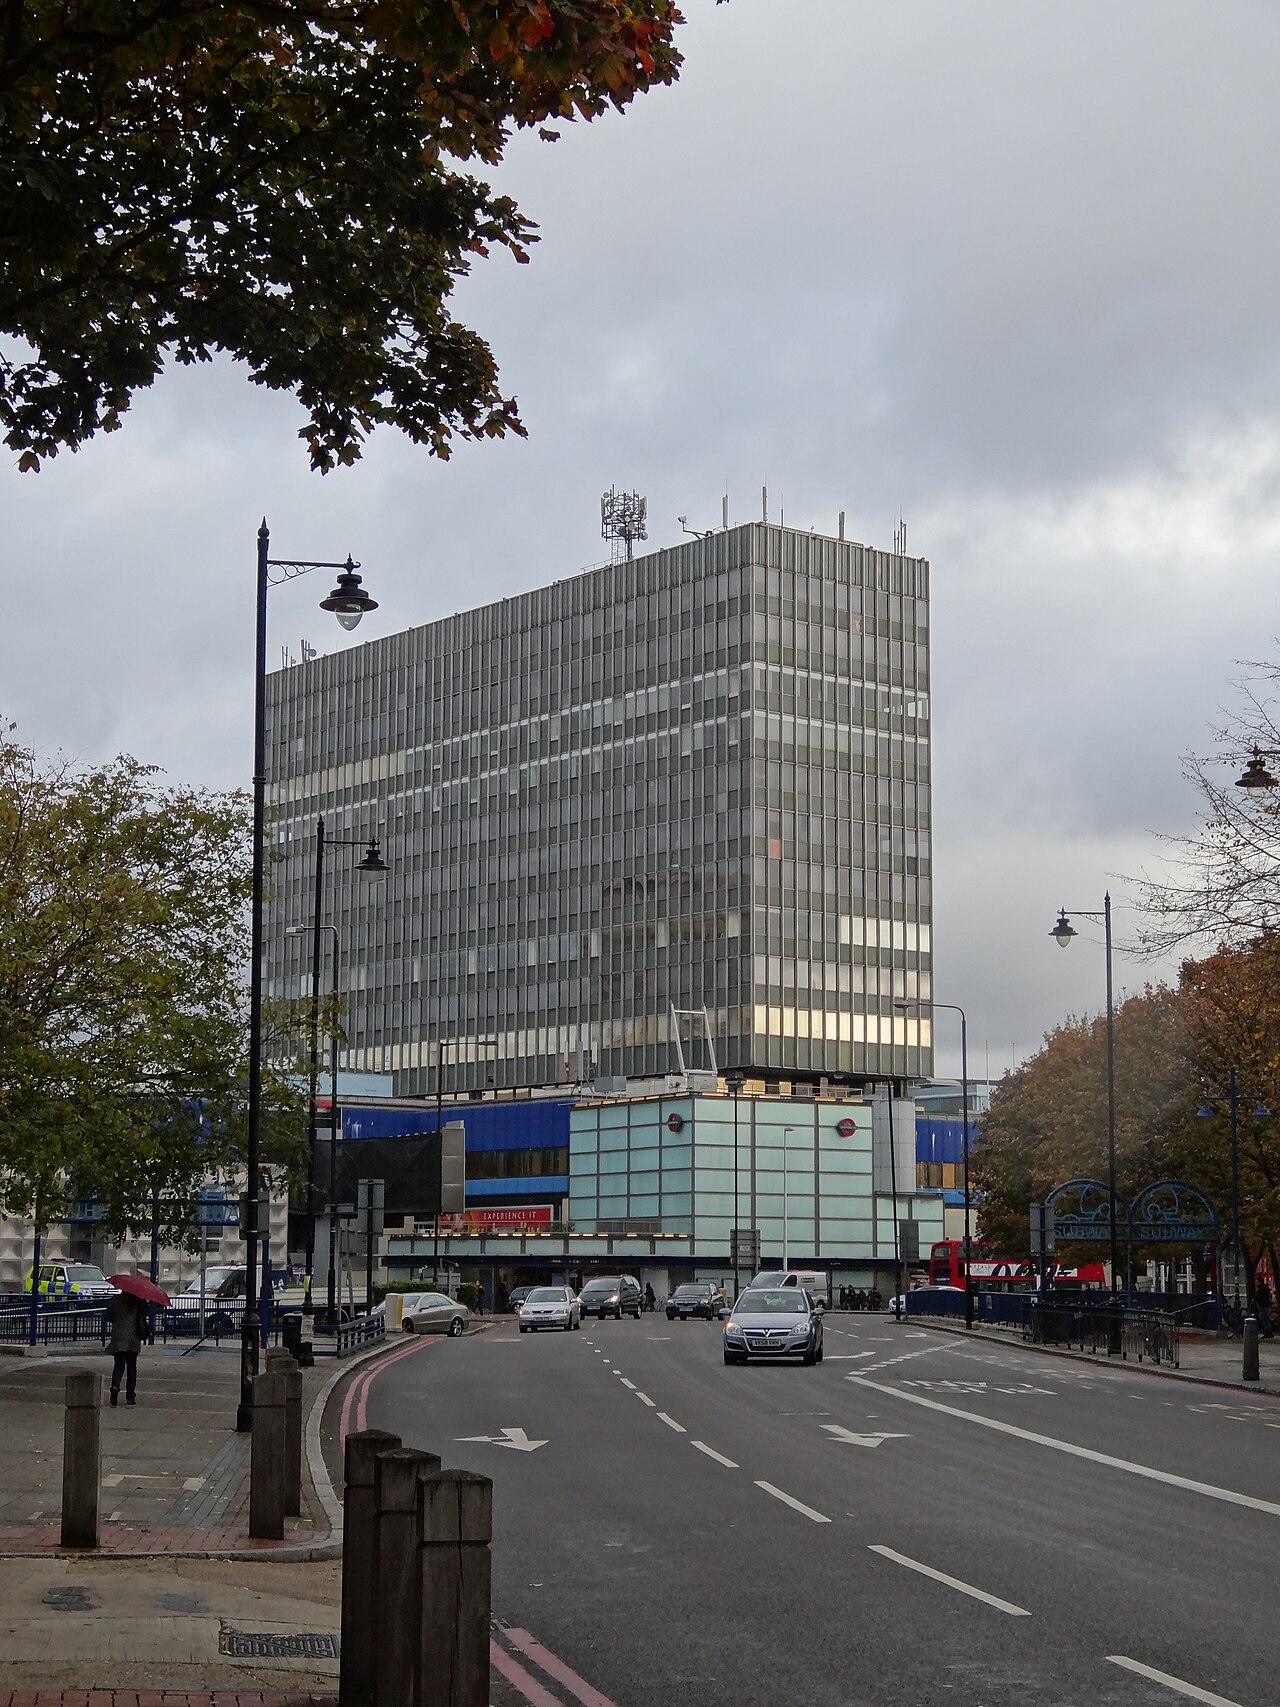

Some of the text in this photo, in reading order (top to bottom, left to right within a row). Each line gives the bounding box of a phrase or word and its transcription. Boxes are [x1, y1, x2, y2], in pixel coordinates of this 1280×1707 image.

[483, 1211, 537, 1220] EXPERIENCE IT
[1053, 1225, 1112, 1239] SUBWA
[1141, 1225, 1207, 1239] SUBWAY
